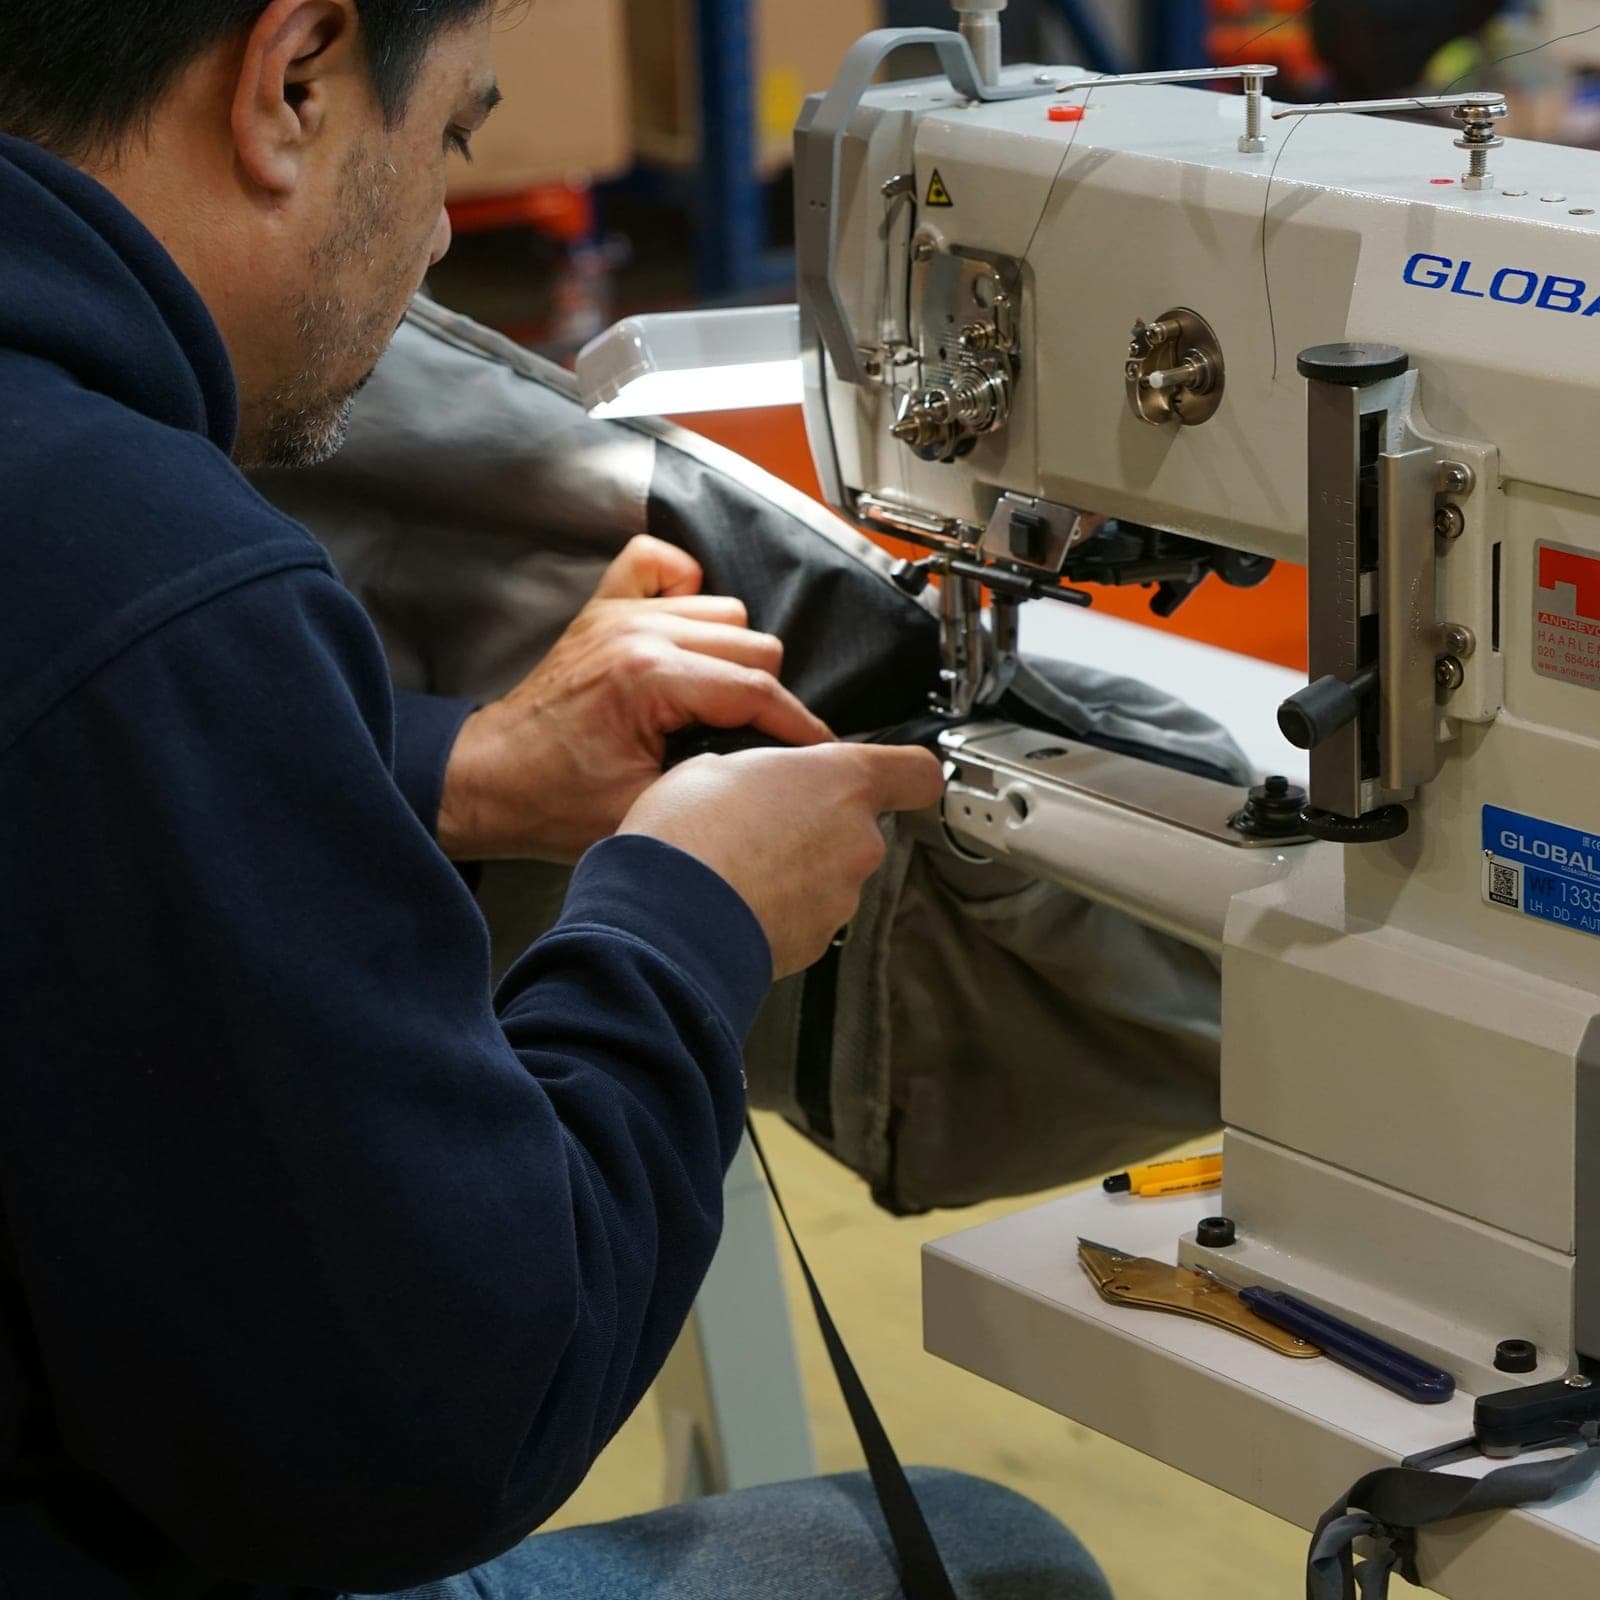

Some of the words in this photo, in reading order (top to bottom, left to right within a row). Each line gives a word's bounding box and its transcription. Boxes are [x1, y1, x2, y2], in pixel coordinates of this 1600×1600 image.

[1501, 830, 1600, 875] GLOBAL
[1530, 899, 1543, 913] LH
[1553, 906, 1570, 921] DD
[1561, 882, 1600, 913] 1335
